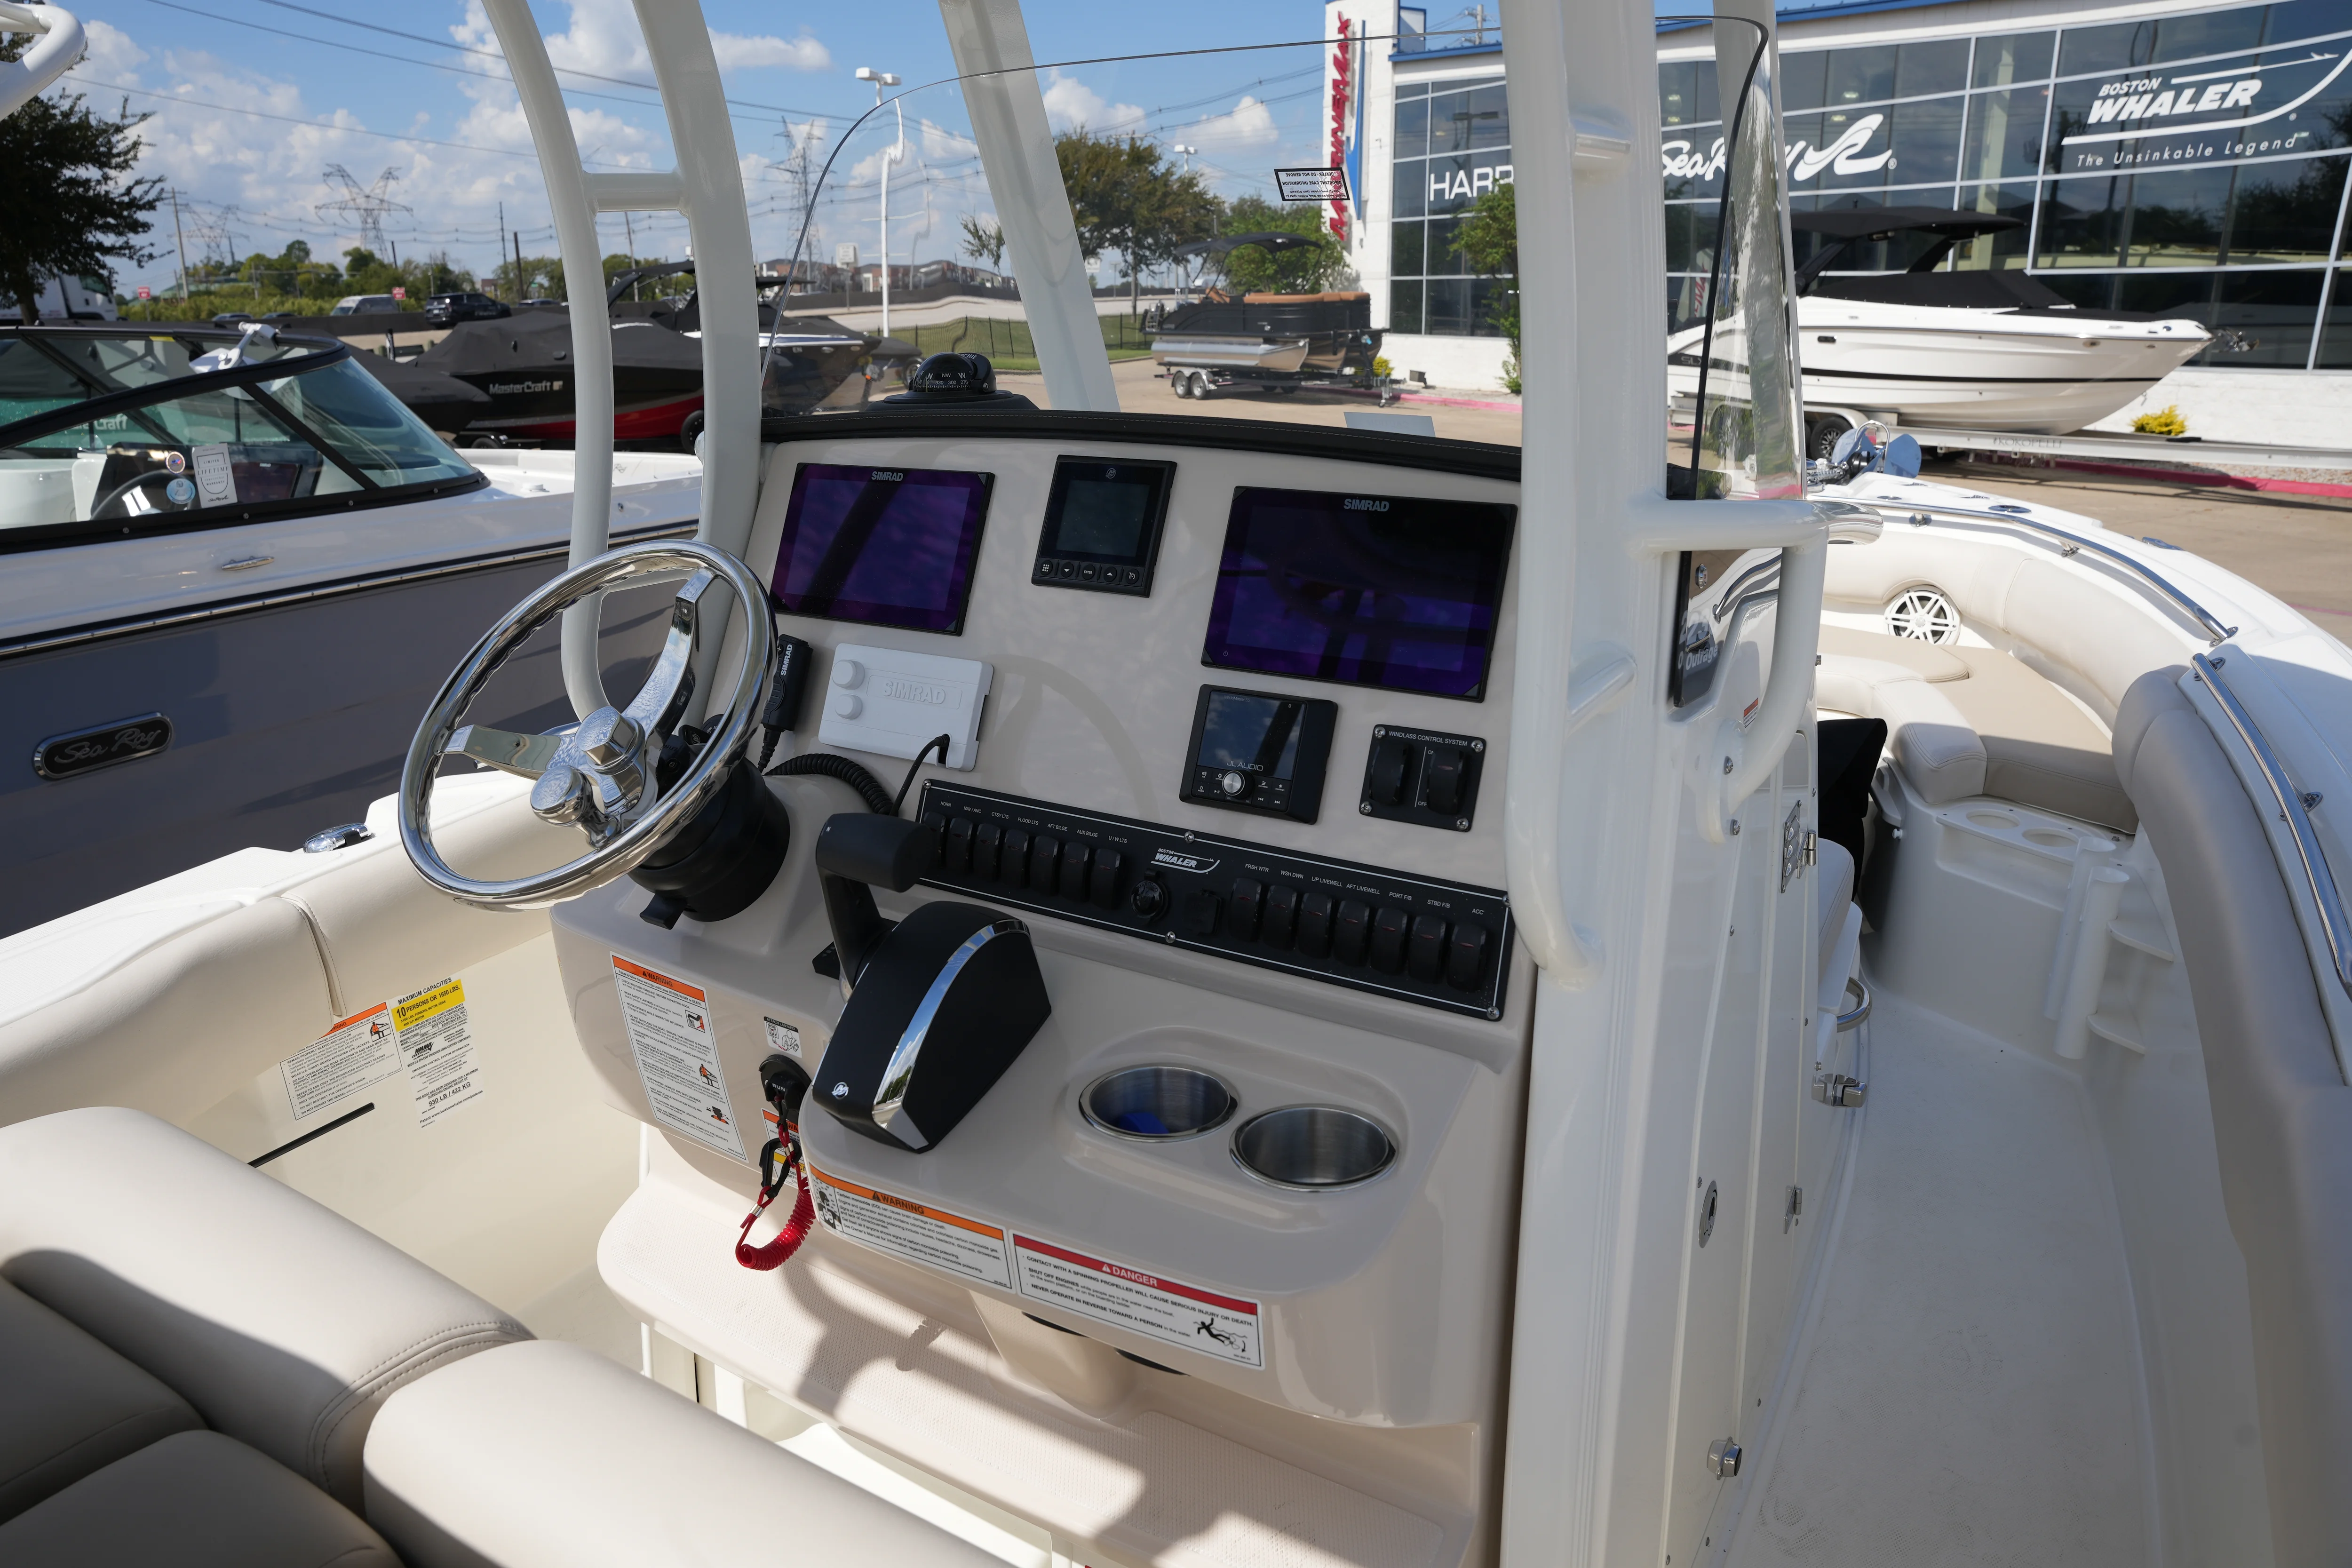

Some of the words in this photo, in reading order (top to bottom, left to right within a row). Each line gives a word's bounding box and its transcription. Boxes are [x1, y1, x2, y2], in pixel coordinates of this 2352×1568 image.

[2098, 77, 2162, 97] BOSTON
[2087, 79, 2262, 124] WHALER
[1662, 140, 1711, 178] Sea
[2077, 154, 2104, 167] The
[2114, 142, 2213, 165] Unsinkable
[2225, 135, 2297, 157] Legend
[489, 381, 551, 395] MasterCraft
[1998, 438, 2062, 448] KOKOPELLI
[198, 466, 229, 476] LIFETIME
[871, 471, 904, 482] SIMRAD
[1343, 499, 1390, 512] SIMRAD
[780, 644, 793, 676] SIMRAD
[1685, 645, 1718, 670] Outrage
[884, 680, 946, 705] SIMRAD
[54, 742, 108, 763] Sea
[111, 728, 161, 752] Ray
[1389, 731, 1416, 740] WINDLASS
[1417, 734, 1444, 743] CONTROL
[1445, 738, 1468, 747] SYSTEM
[1237, 761, 1263, 772] AUDIO
[1155, 853, 1197, 868] WHALER
[1319, 878, 1343, 887] LIVEWELL
[1356, 885, 1381, 895] LIVEWELL
[647, 972, 673, 987] WARNING
[397, 989, 422, 1005] MAXIMUM
[422, 976, 452, 994] CAPACITIES
[396, 1005, 407, 1019] 10
[405, 997, 429, 1013] PERSONS
[438, 989, 449, 998] 1650
[449, 984, 460, 993] LBS.
[414, 1008, 428, 1017] PERSONS,
[431, 1019, 445, 1028] BOSTON
[446, 1012, 460, 1021] WHALER,
[441, 1015, 462, 1027] EDGEWATER,
[326, 1021, 347, 1033] ARNING
[779, 1022, 795, 1031] LANYARD
[412, 1063, 427, 1073] EMISSIONS
[427, 1057, 440, 1066] CONTROL
[451, 1043, 470, 1054] INFORMATION
[428, 1097, 439, 1106] 930
[451, 1085, 461, 1095] 422
[461, 1081, 471, 1089] KG
[772, 1083, 786, 1092] RUN
[420, 1115, 431, 1123] Patent
[431, 1090, 483, 1118] www.bostonwhaler.com/patents
[881, 1194, 924, 1214] WARNING
[1028, 1267, 1043, 1276] SHUT
[1055, 1275, 1079, 1287] ENGINES
[1112, 1266, 1157, 1287] DANGER
[1026, 1256, 1052, 1267] CONTACT
[1052, 1264, 1067, 1272] WITH
[1073, 1270, 1099, 1282] SPINNING
[1100, 1279, 1133, 1293] PROPELLER
[1135, 1289, 1148, 1297] WILL
[1149, 1294, 1169, 1304] CAUSE
[1170, 1300, 1196, 1312] SERIOUS
[1197, 1308, 1219, 1319] INJURY
[1231, 1317, 1253, 1328] DEATH.
[1031, 1283, 1049, 1293] NEVER
[1049, 1289, 1074, 1301] OPERATE
[1082, 1299, 1107, 1312] REVERSE
[1108, 1307, 1133, 1320] TOWARD
[1139, 1317, 1163, 1329] PERSON
